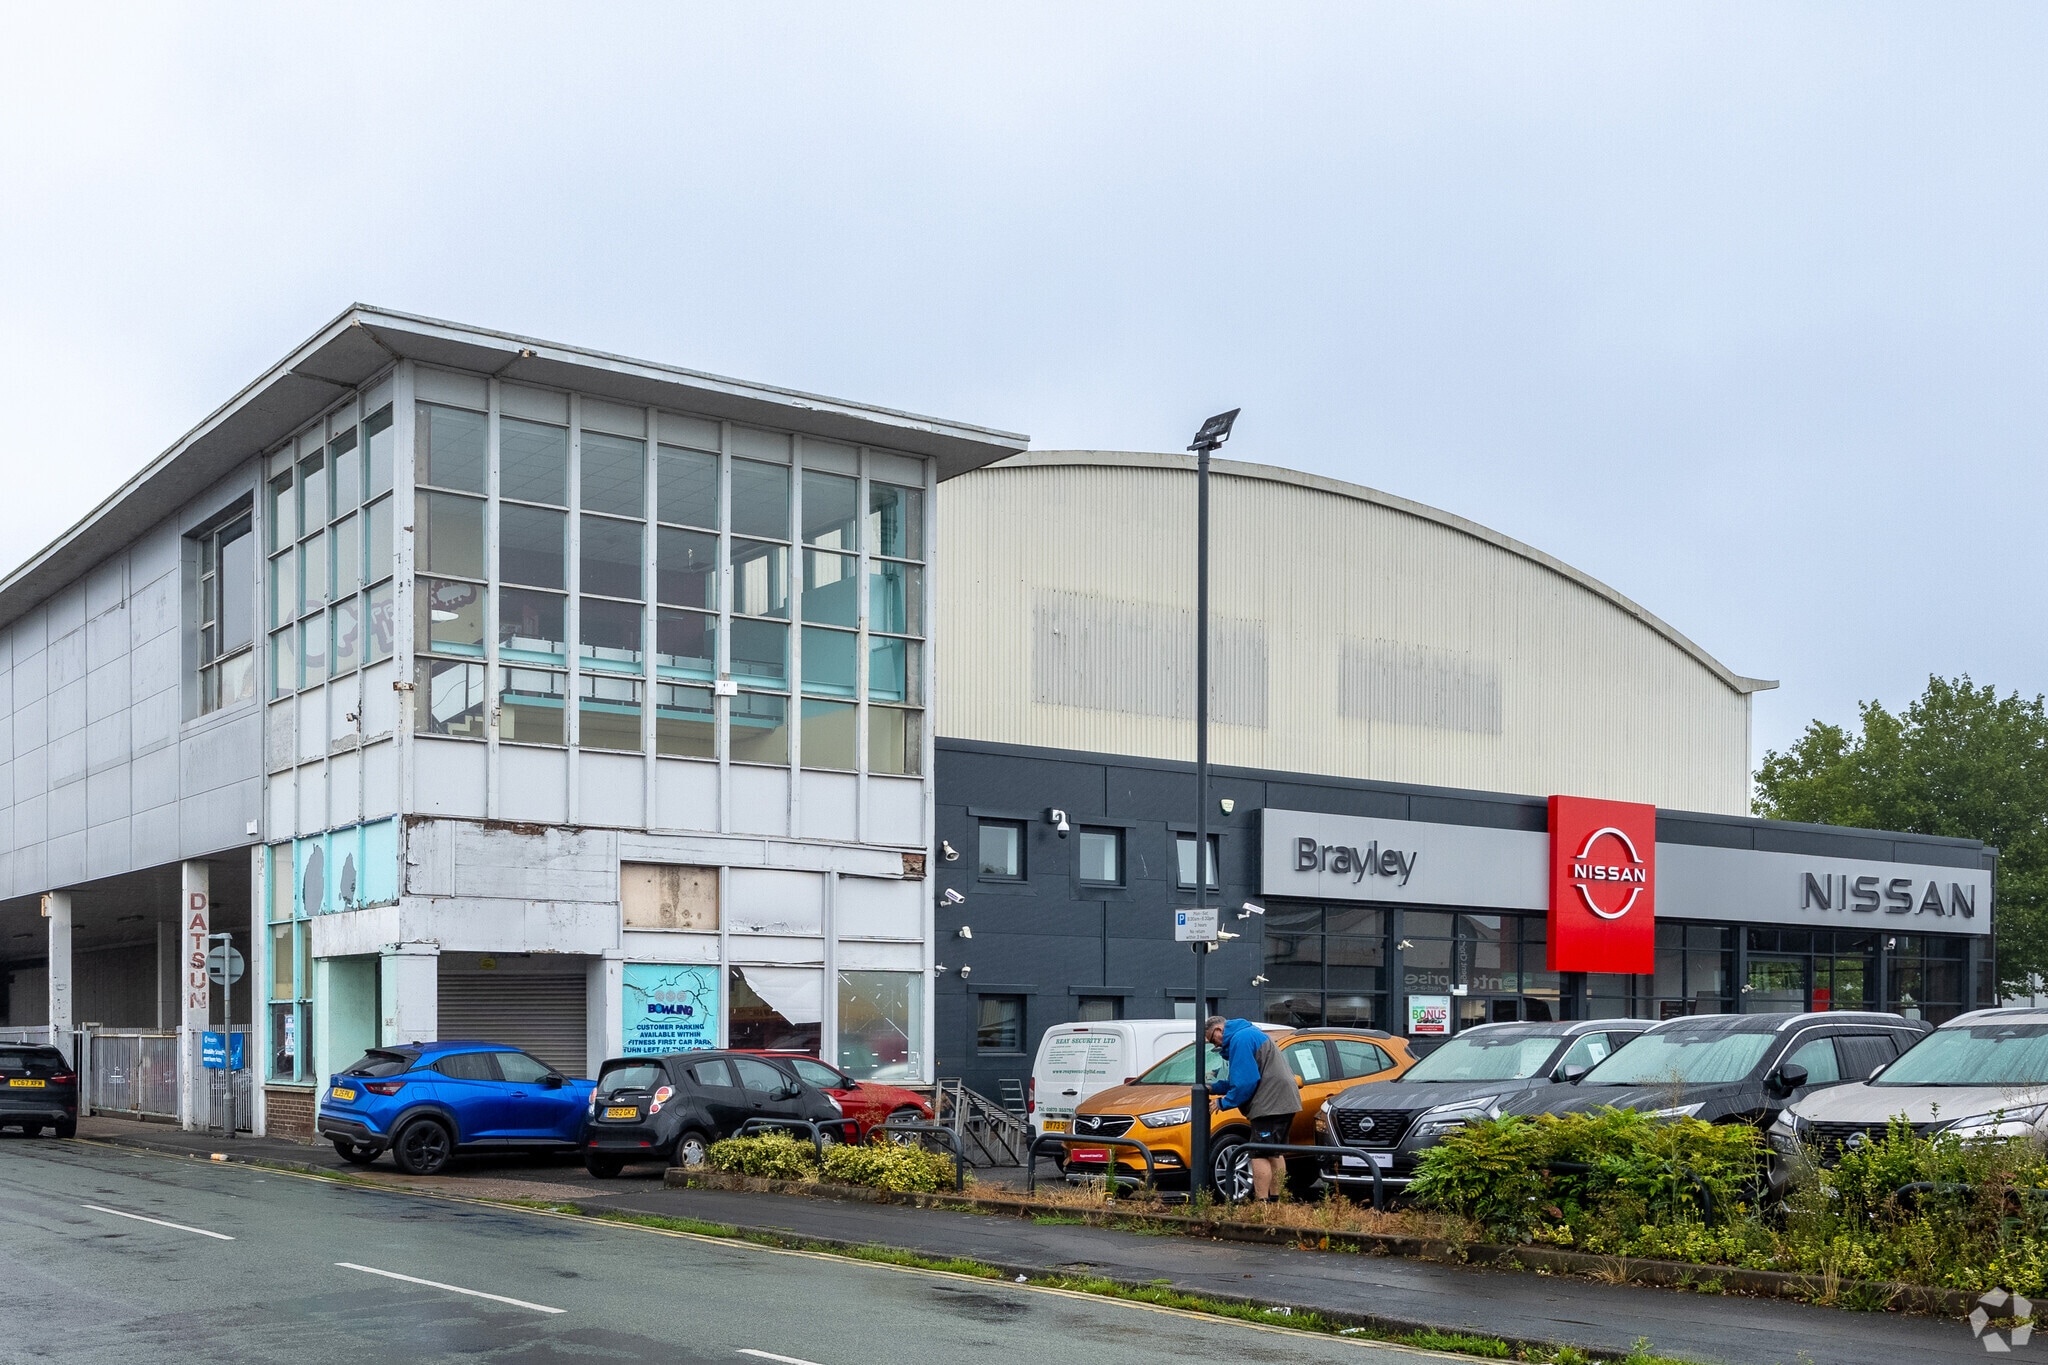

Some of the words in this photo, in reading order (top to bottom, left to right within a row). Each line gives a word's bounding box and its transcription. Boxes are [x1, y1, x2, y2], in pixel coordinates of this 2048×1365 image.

[1294, 837, 1417, 886] Brayley
[1574, 864, 1646, 882] NISSAN
[1801, 872, 1975, 918] NISSAN
[189, 893, 207, 1008] DATSUN
[648, 1004, 693, 1016] BOWLING
[1412, 1009, 1447, 1019] BONUS
